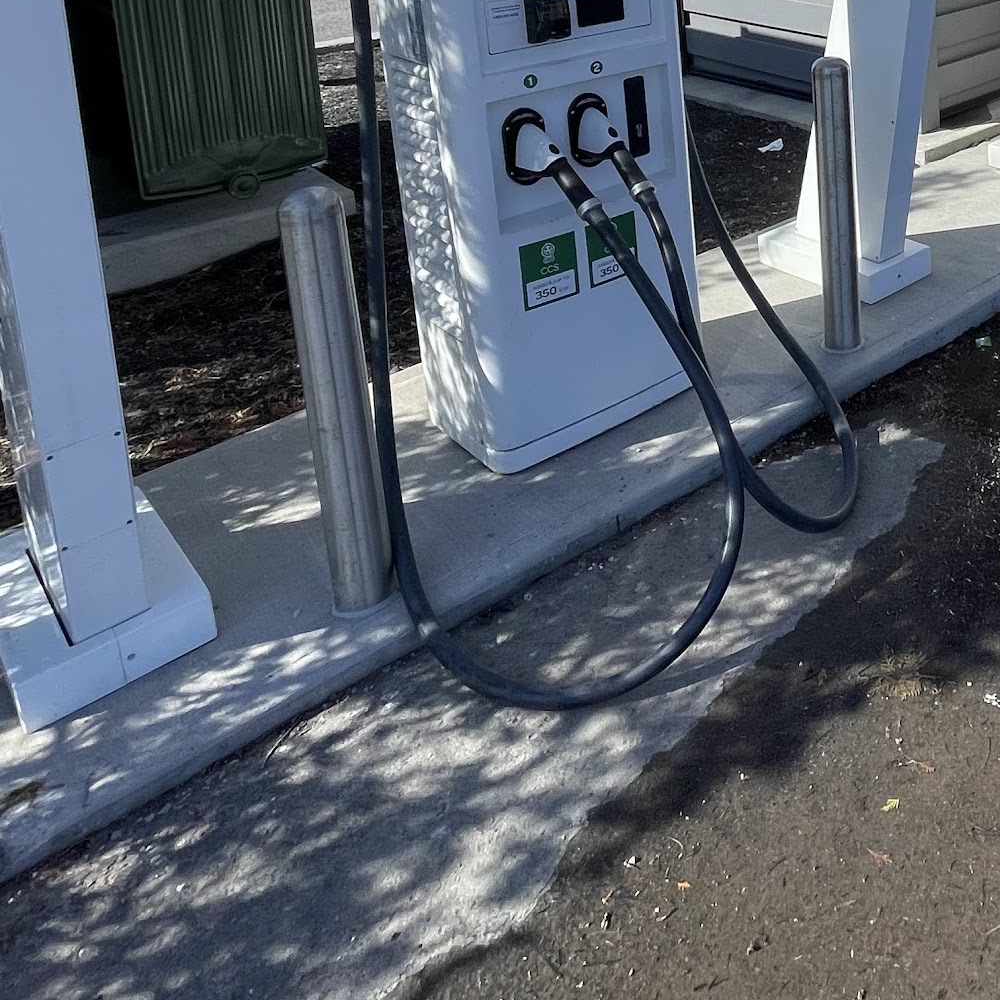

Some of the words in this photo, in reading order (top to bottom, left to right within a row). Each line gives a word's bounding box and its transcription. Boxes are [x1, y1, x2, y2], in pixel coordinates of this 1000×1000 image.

[592, 62, 601, 73] 2
[540, 263, 560, 276] CCS
[600, 263, 620, 278] 350
[534, 286, 557, 301] 350
